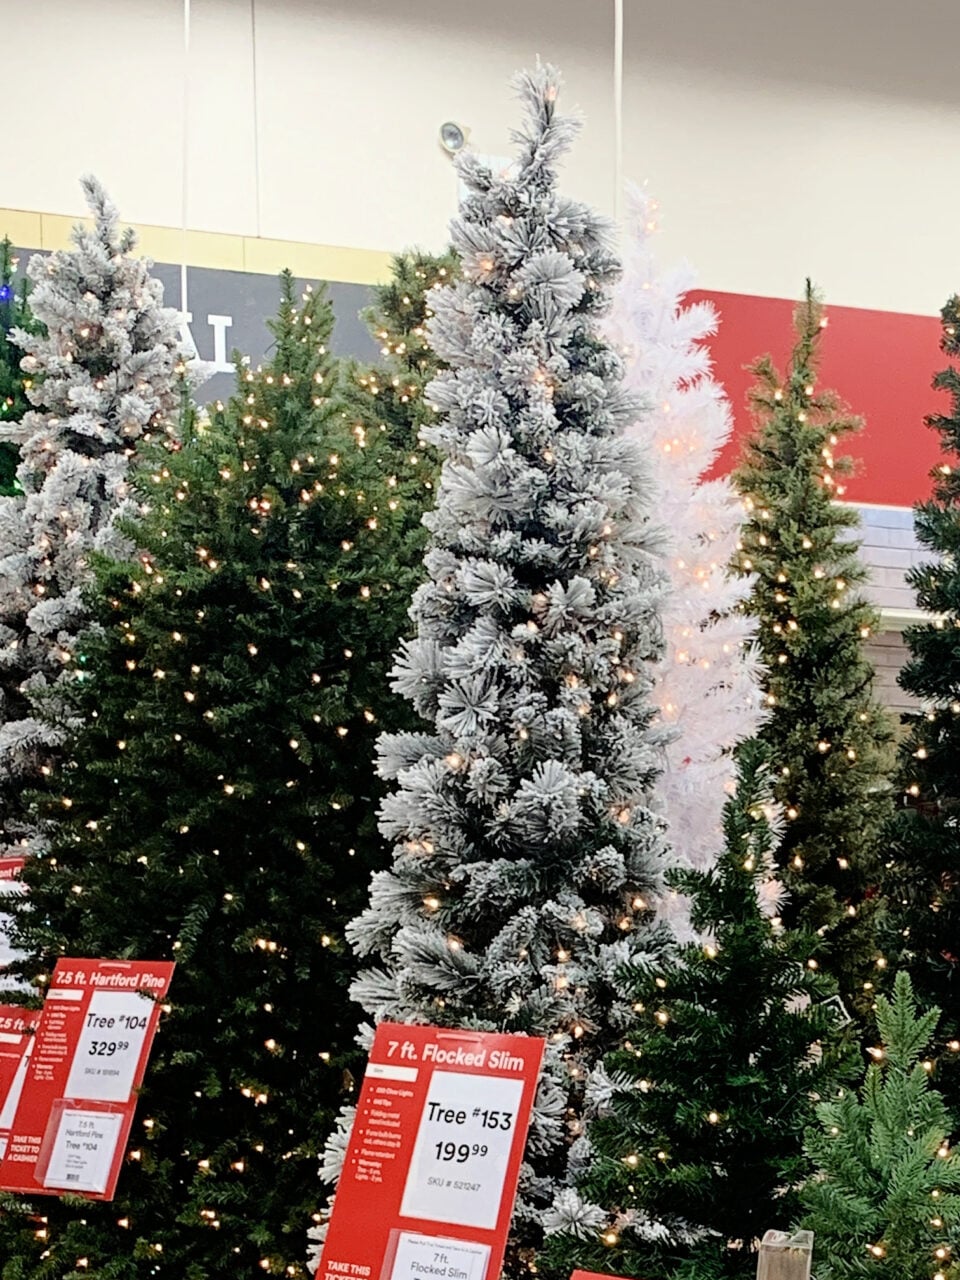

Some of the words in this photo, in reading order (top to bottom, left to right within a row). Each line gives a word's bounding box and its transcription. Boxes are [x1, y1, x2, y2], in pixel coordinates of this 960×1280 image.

[56, 971, 73, 985] 7.5
[74, 971, 87, 985] ft.
[89, 972, 138, 987] Hartford
[139, 973, 166, 988] Pine
[87, 1013, 115, 1028] Tree
[119, 1014, 148, 1030] #104
[387, 1041, 399, 1058] 7
[400, 1041, 419, 1060] ft.
[422, 1044, 486, 1067] Flocked
[487, 1051, 525, 1072] Slim
[427, 1102, 467, 1125] Tree
[472, 1107, 513, 1131] #153
[66, 1140, 81, 1151] Tree
[427, 1175, 444, 1188] SKU
[327, 1260, 350, 1274] TAKE
[350, 1263, 372, 1277] THIS
[410, 1261, 447, 1277] Flocked
[447, 1267, 468, 1280] Slim
